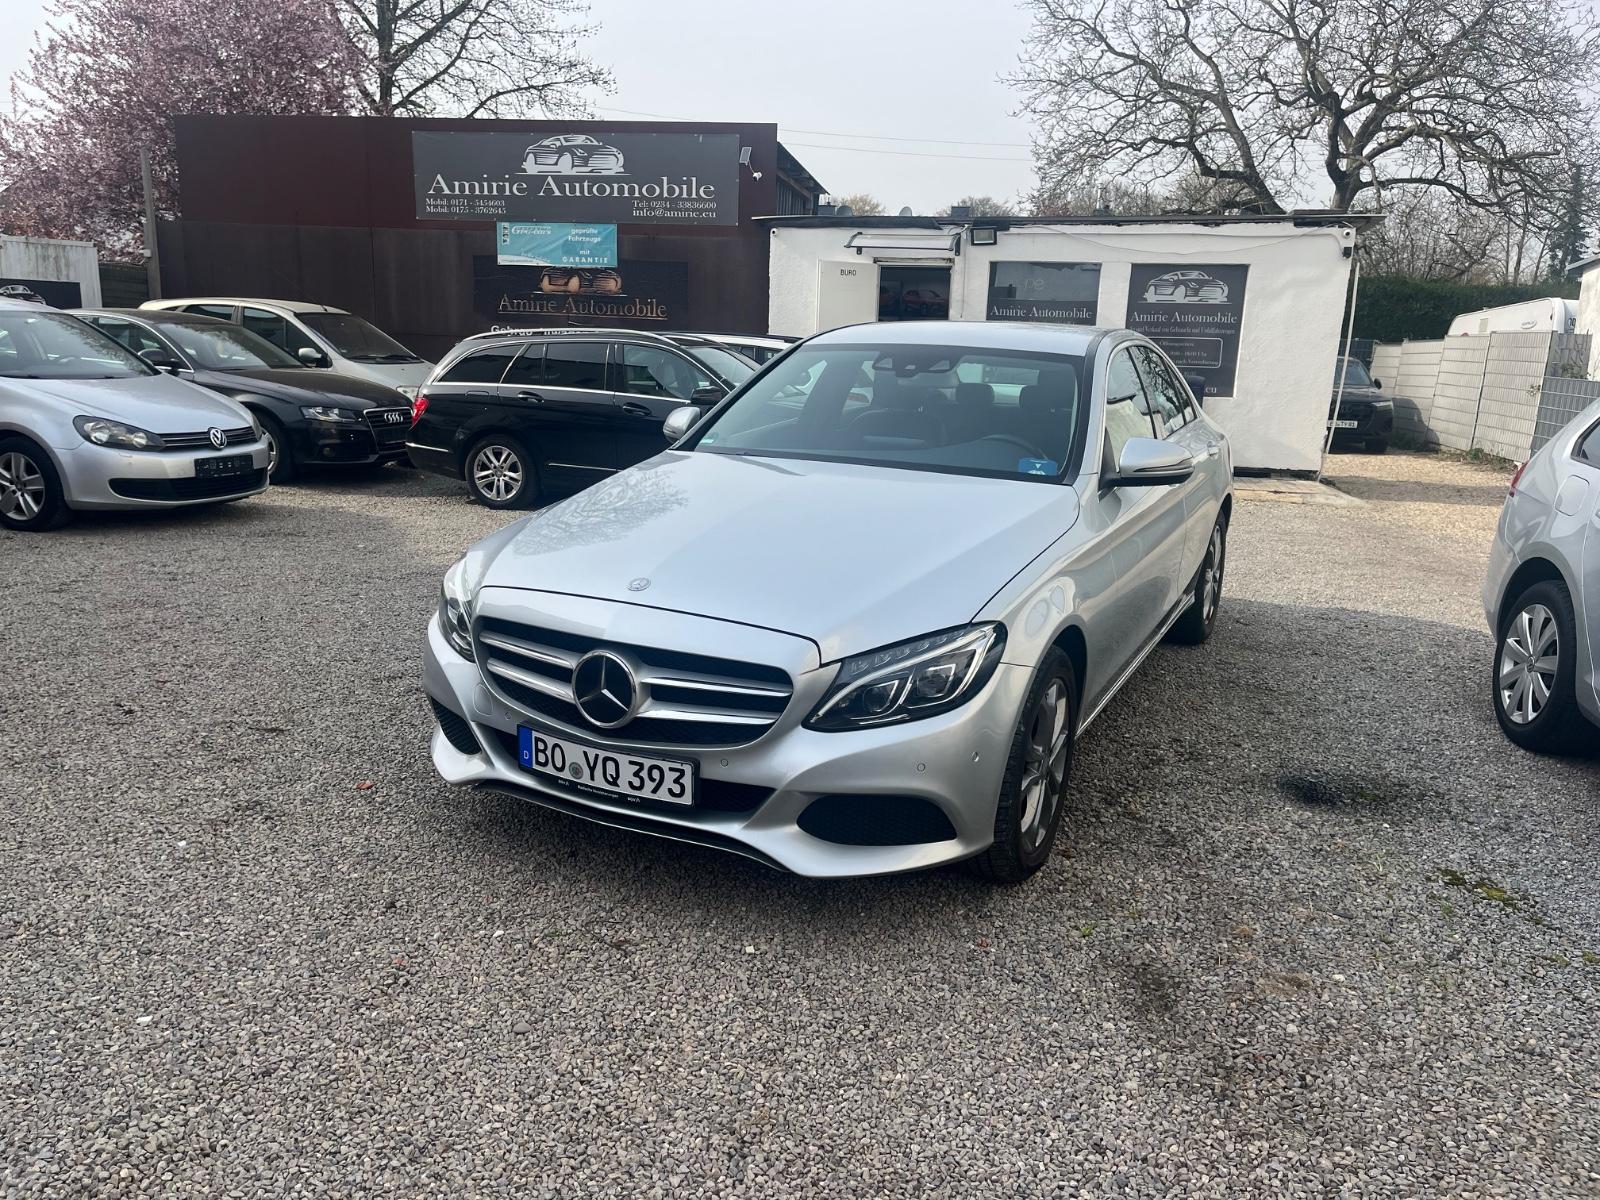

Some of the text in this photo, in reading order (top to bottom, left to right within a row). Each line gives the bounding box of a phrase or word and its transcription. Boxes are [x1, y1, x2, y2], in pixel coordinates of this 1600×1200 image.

[427, 173, 715, 199] Amirie Automobile
[632, 200, 649, 208] Tel:
[650, 200, 670, 208] 0234
[632, 208, 717, 218] info@amirie.eu
[499, 294, 668, 318] Amirie Automobile
[990, 305, 1093, 319] Amirie Automobile
[1130, 311, 1238, 324] Amirie Automobile
[523, 750, 529, 759] D
[534, 736, 686, 798] BO YQ 393
